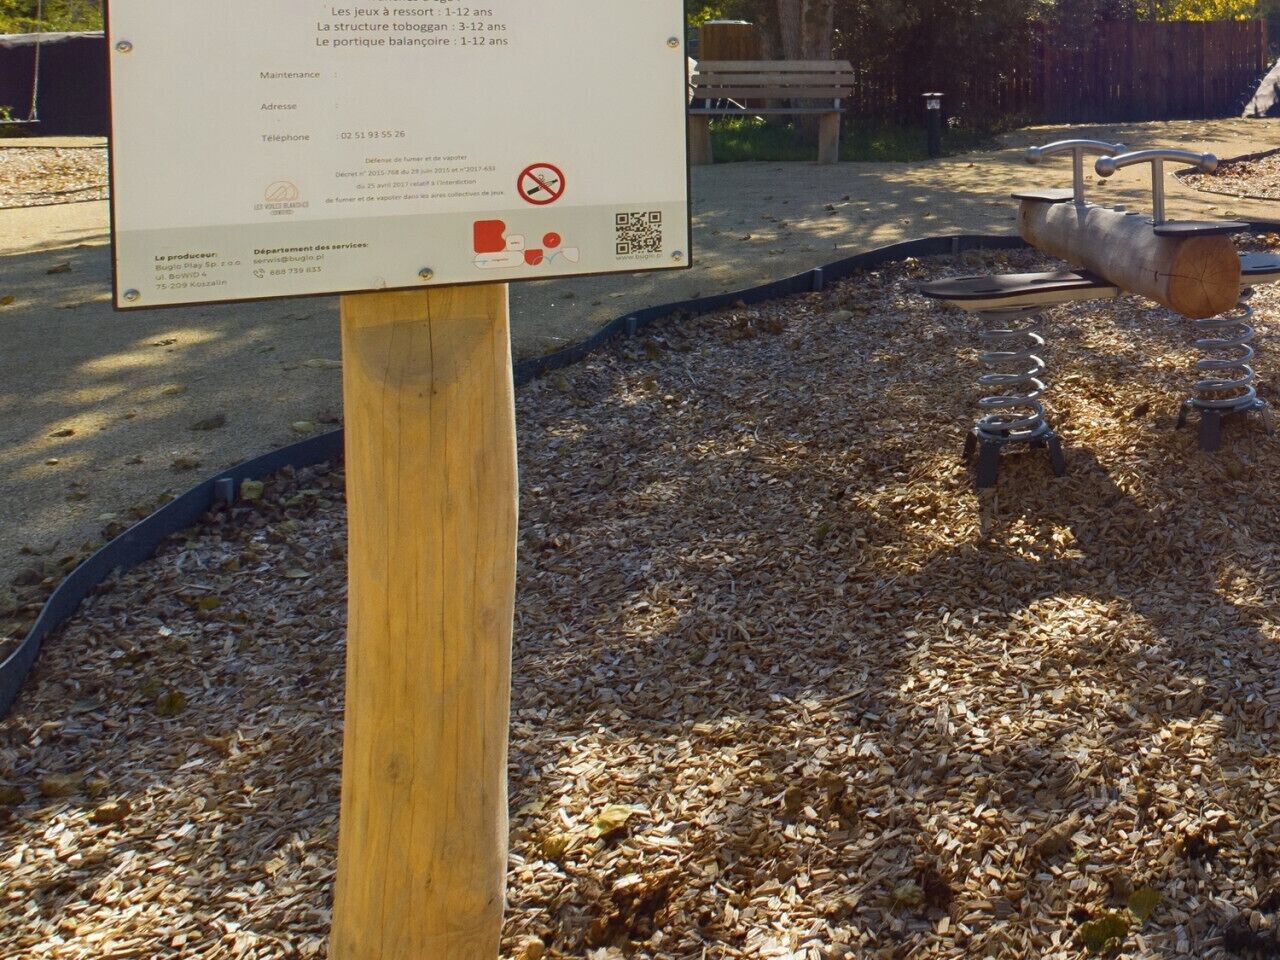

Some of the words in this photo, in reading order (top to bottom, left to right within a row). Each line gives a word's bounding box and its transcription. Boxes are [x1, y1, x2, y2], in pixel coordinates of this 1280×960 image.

[331, 7, 351, 16] Les
[354, 7, 379, 18] jeux
[383, 7, 390, 16] à
[393, 7, 434, 16] ressort
[445, 7, 470, 17] 1-12
[473, 9, 493, 17] ans
[317, 22, 330, 32] La
[334, 23, 389, 32] structure
[393, 22, 448, 33] toboggan
[458, 22, 484, 32] 3-12
[316, 37, 330, 47] Le
[333, 37, 386, 48] portique
[388, 36, 450, 48] balançoire
[461, 37, 485, 46] 1-12
[488, 38, 508, 46] ans
[260, 71, 320, 79] Maintenance
[260, 103, 297, 111] Adresse
[261, 133, 310, 143] Téléphone
[341, 132, 352, 140] 02
[355, 131, 365, 139] 51
[368, 131, 379, 139] 93
[394, 130, 406, 138] 26
[253, 245, 313, 255] Département
[332, 242, 369, 250] services:
[168, 252, 218, 261] produceur:
